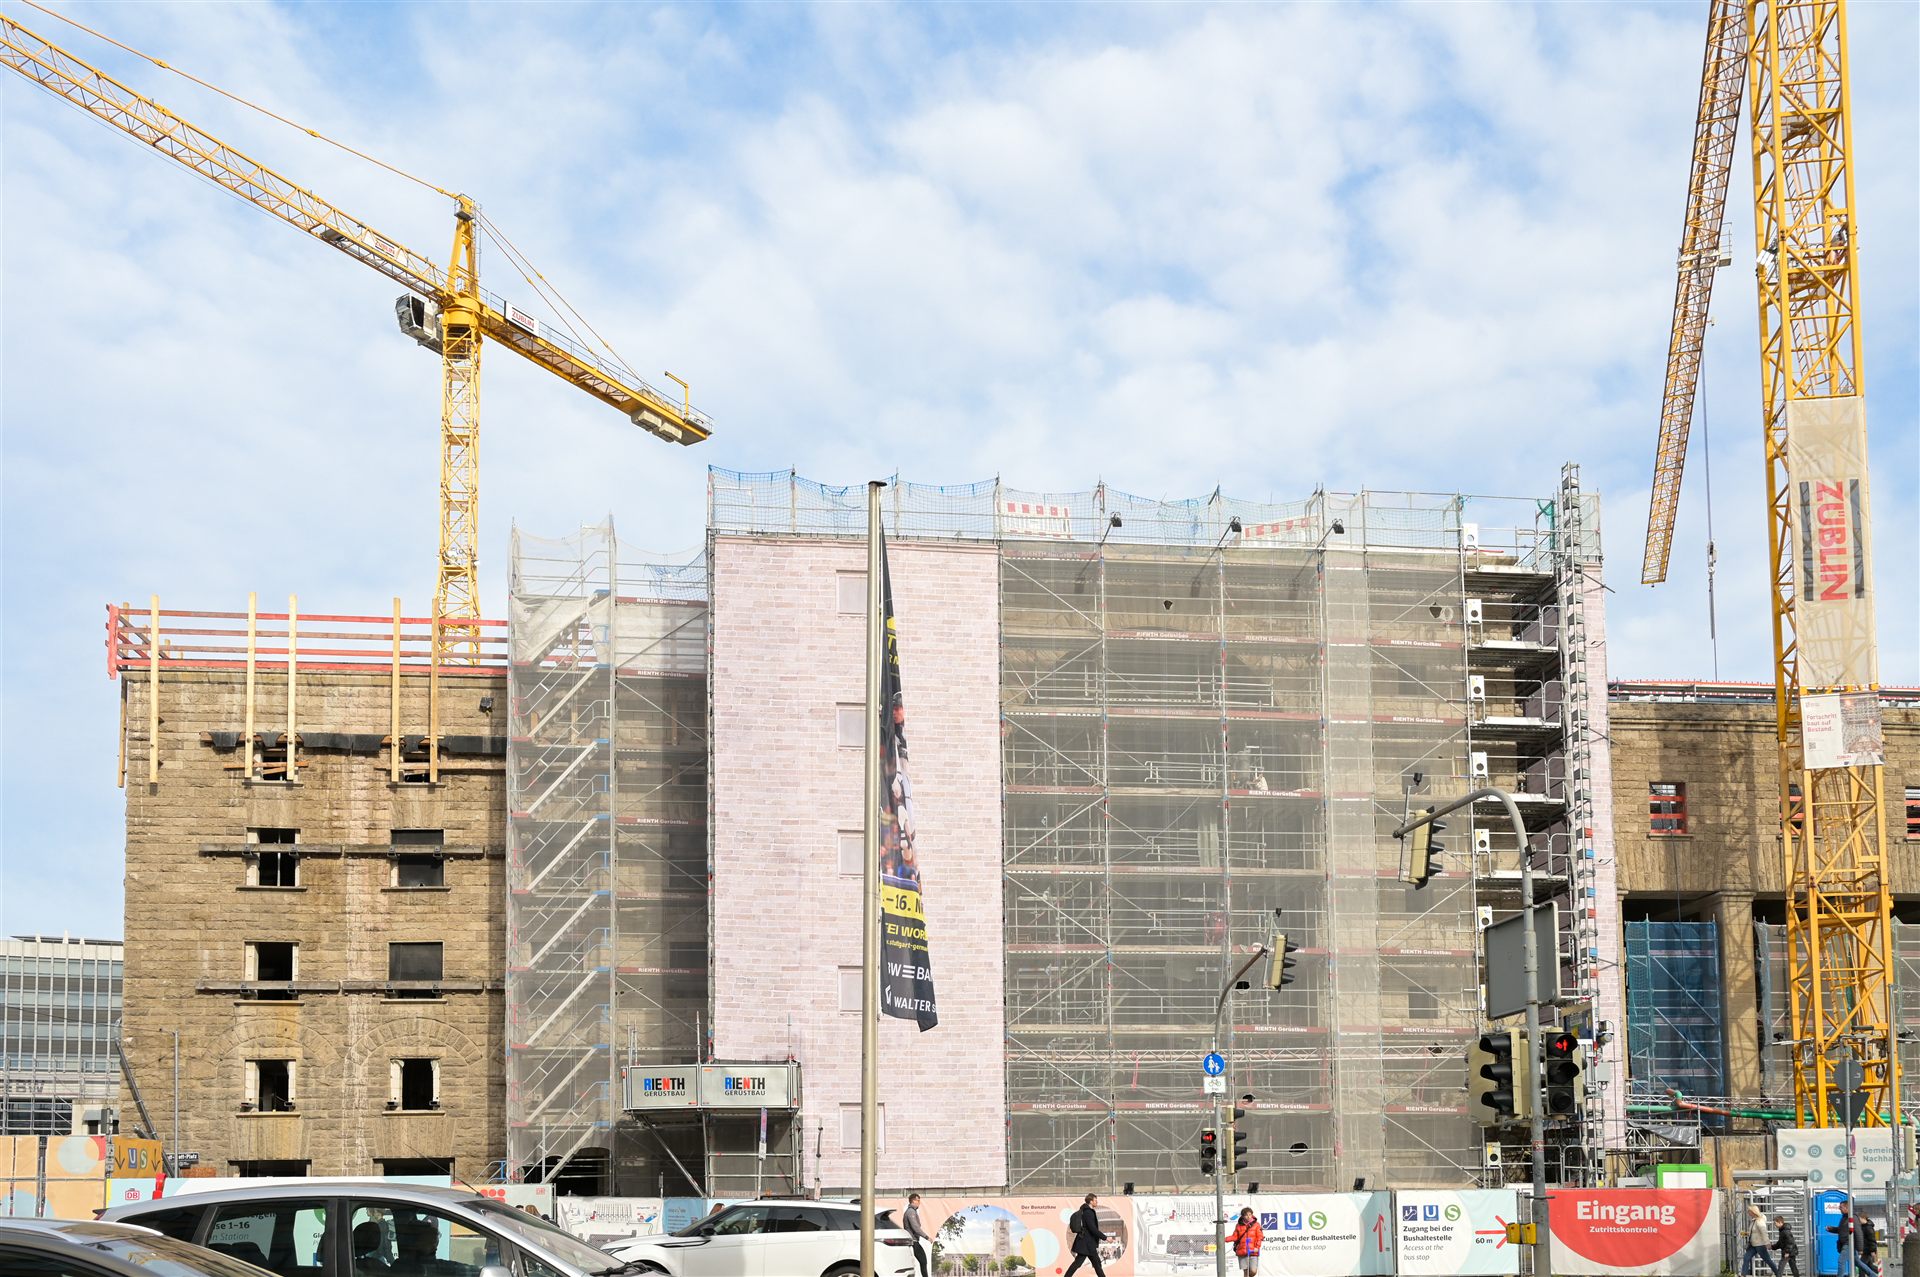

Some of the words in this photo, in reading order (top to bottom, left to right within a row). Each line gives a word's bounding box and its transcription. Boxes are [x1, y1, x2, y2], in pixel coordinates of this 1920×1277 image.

[1816, 480, 1848, 600] ZÜBLIN
[894, 996, 931, 1012] WALTER
[643, 1077, 685, 1090] RIENTH
[724, 1077, 766, 1090] RIENTH
[126, 1191, 139, 1200] DB
[1425, 1205, 1437, 1218] U
[1445, 1205, 1461, 1221] S
[1576, 1200, 1676, 1226] Eingang
[1287, 1212, 1300, 1227] U
[1309, 1211, 1327, 1230] S
[1261, 1235, 1286, 1243] Zugang
[1416, 1254, 1430, 1262] stop
